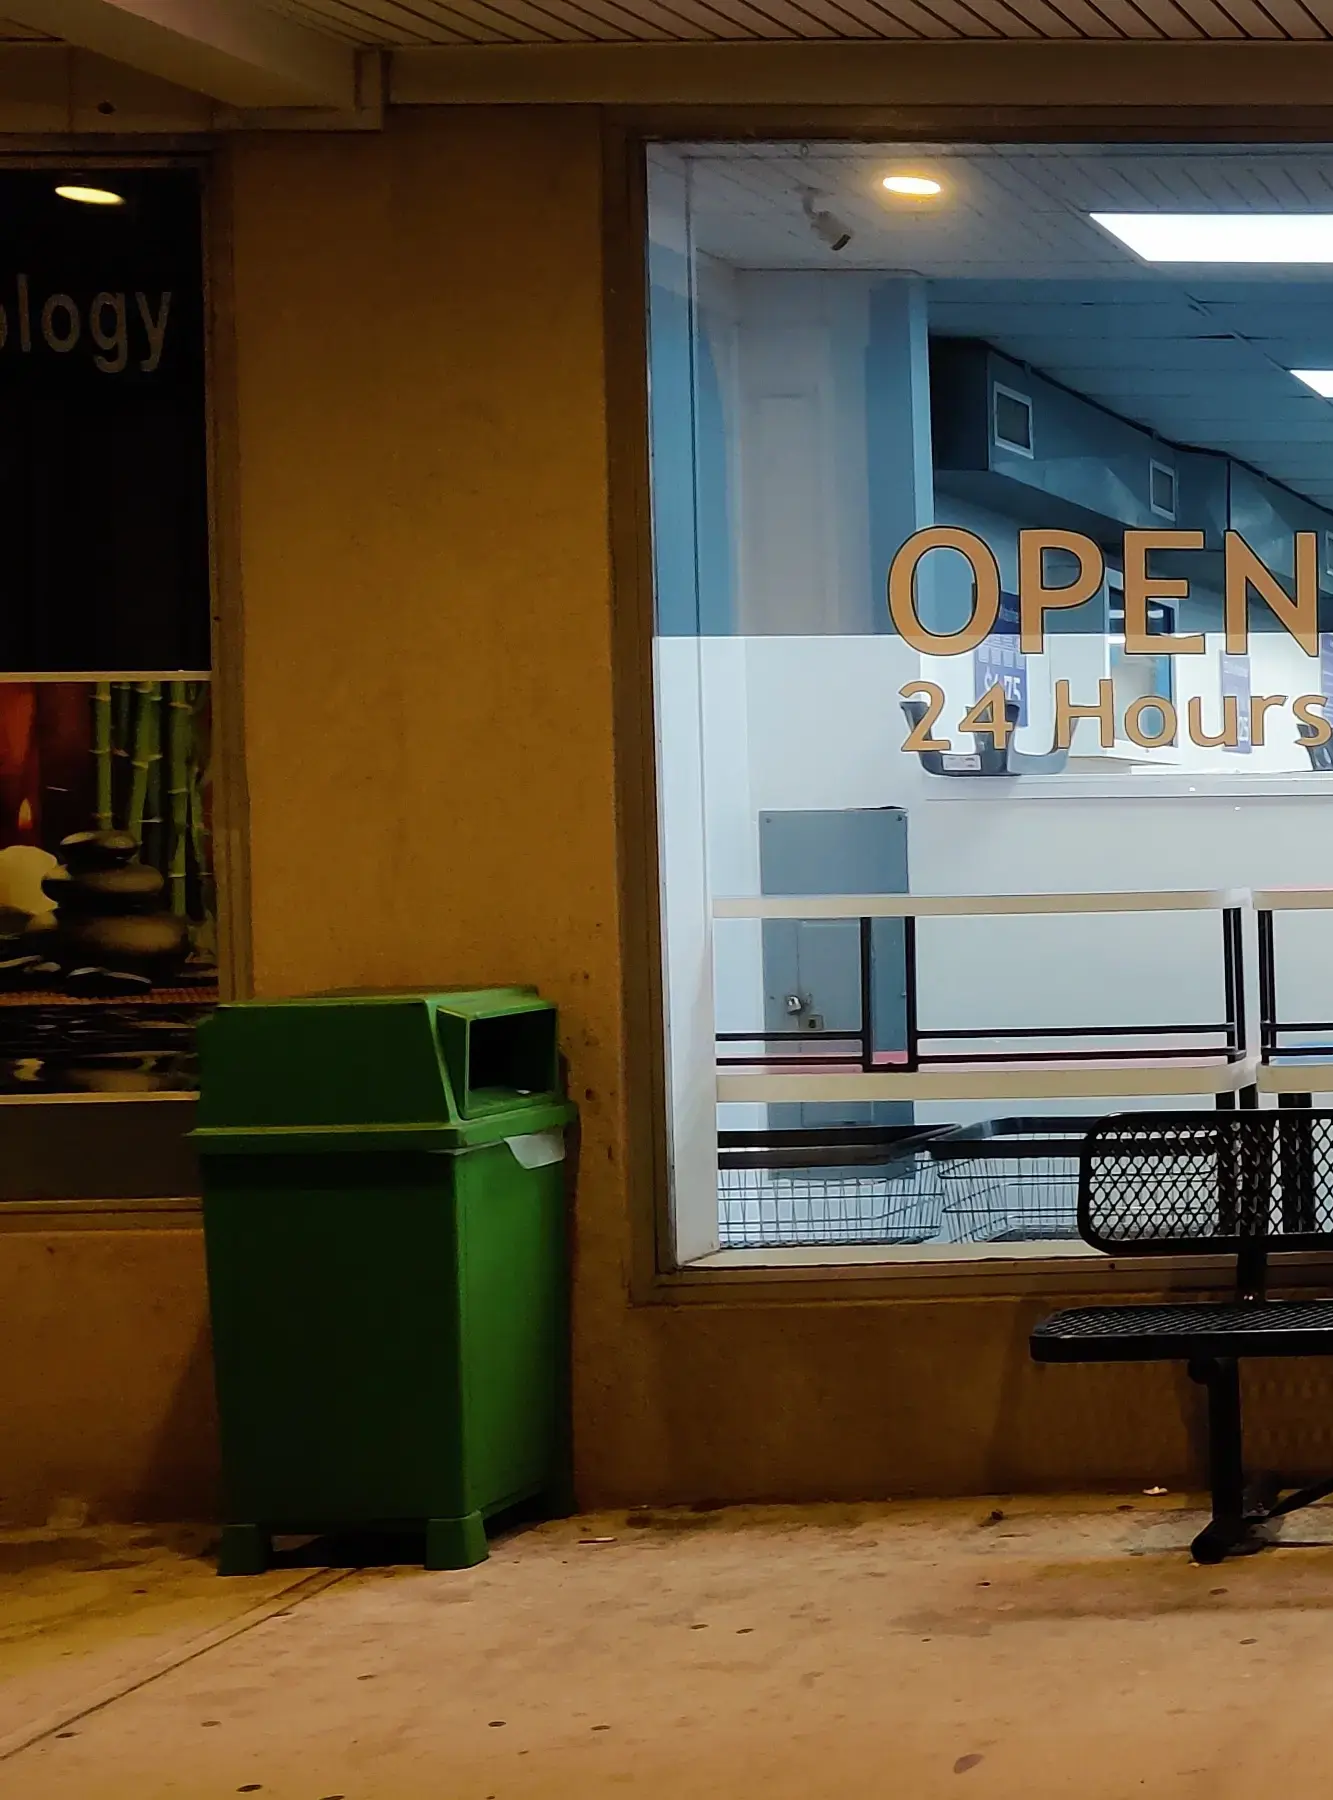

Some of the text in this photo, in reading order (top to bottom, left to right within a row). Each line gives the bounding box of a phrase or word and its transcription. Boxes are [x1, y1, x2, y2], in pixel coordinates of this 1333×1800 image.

[0, 272, 172, 374] logy
[887, 525, 1319, 658] OPEN
[898, 680, 1013, 752] 24
[1055, 678, 1333, 751] Hours
